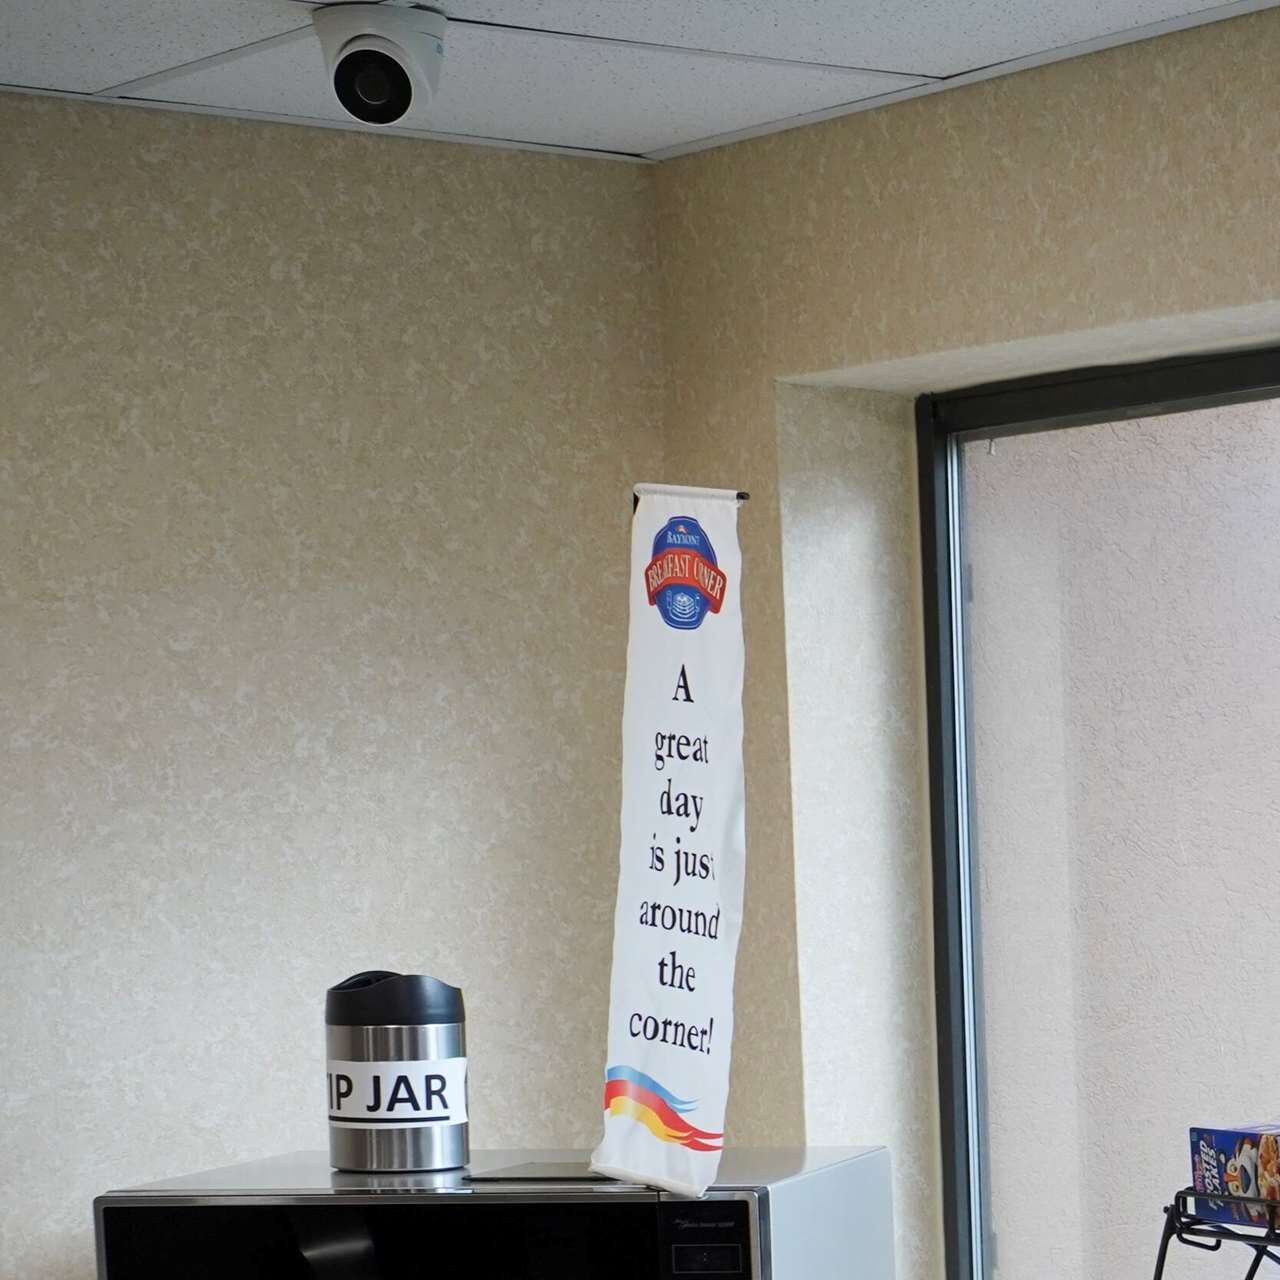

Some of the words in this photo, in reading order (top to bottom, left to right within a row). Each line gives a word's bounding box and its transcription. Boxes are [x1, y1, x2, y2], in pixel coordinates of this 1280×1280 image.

[672, 665, 694, 703] A
[655, 731, 709, 771] great
[660, 779, 704, 832] day
[649, 832, 664, 872] is
[639, 900, 720, 940] around
[657, 951, 696, 992] the
[629, 1012, 714, 1055] corner!
[328, 1073, 353, 1111] IP
[366, 1074, 449, 1112] JAR
